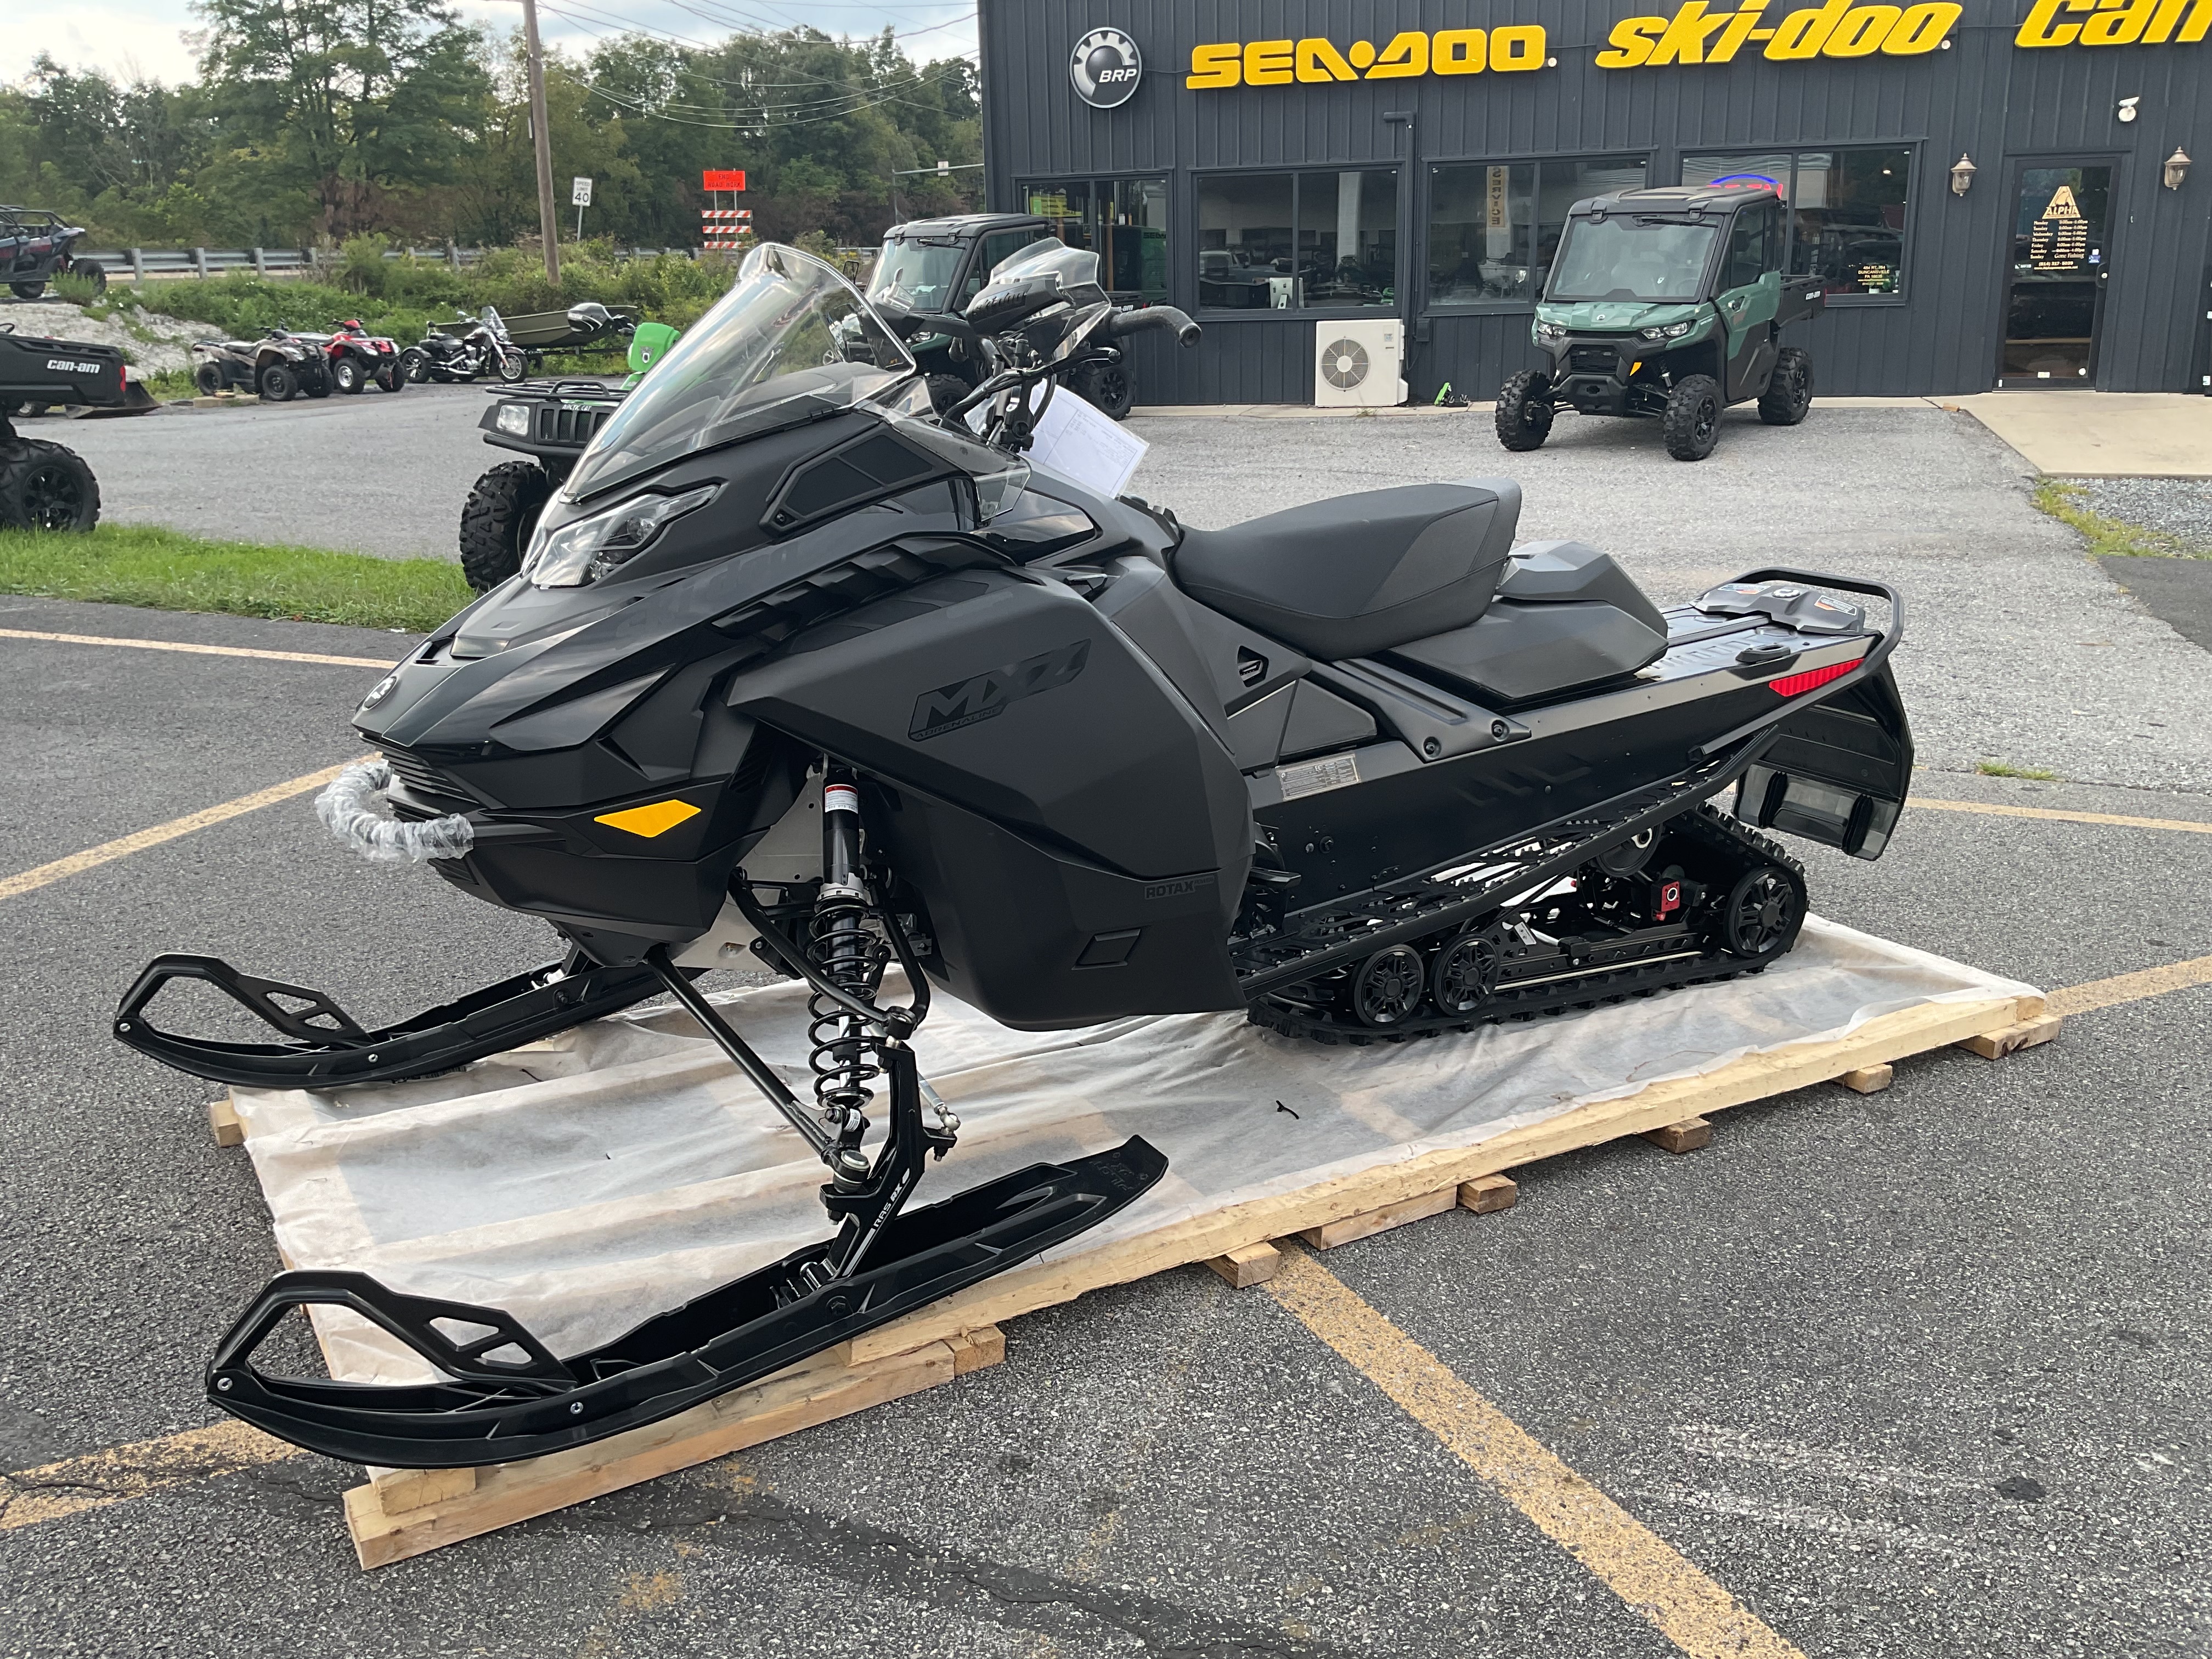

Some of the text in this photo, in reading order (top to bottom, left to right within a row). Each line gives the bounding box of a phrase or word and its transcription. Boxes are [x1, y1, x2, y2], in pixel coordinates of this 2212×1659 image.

[1595, 0, 1962, 69] ski-doo
[1099, 69, 1137, 83] BRP
[574, 192, 589, 202] 40
[2046, 206, 2080, 215] ALPHA
[47, 360, 100, 373] can-am
[916, 706, 1004, 738] ADRENALINE
[1146, 880, 1194, 898] ROTAX
[873, 1183, 902, 1227] RAS RX
